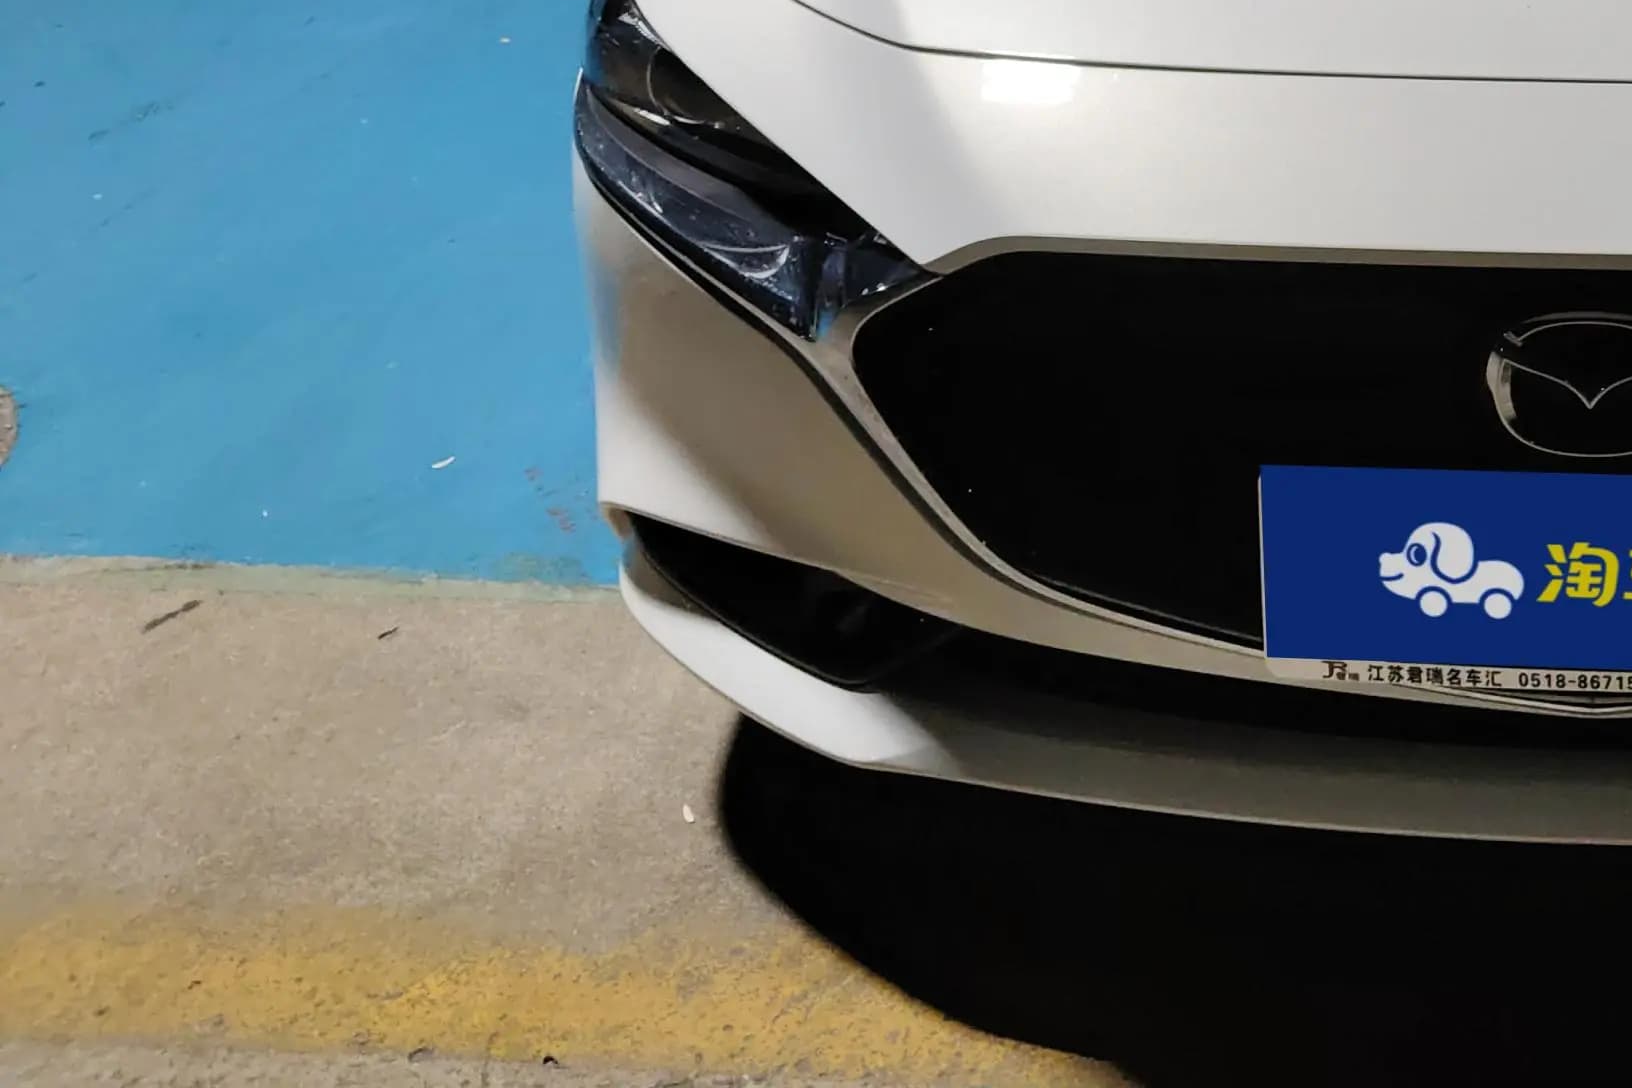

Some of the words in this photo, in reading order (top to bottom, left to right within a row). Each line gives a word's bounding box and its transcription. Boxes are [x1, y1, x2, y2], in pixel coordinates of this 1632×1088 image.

[1368, 664, 1502, 687] 江苏君瑞名车汇
